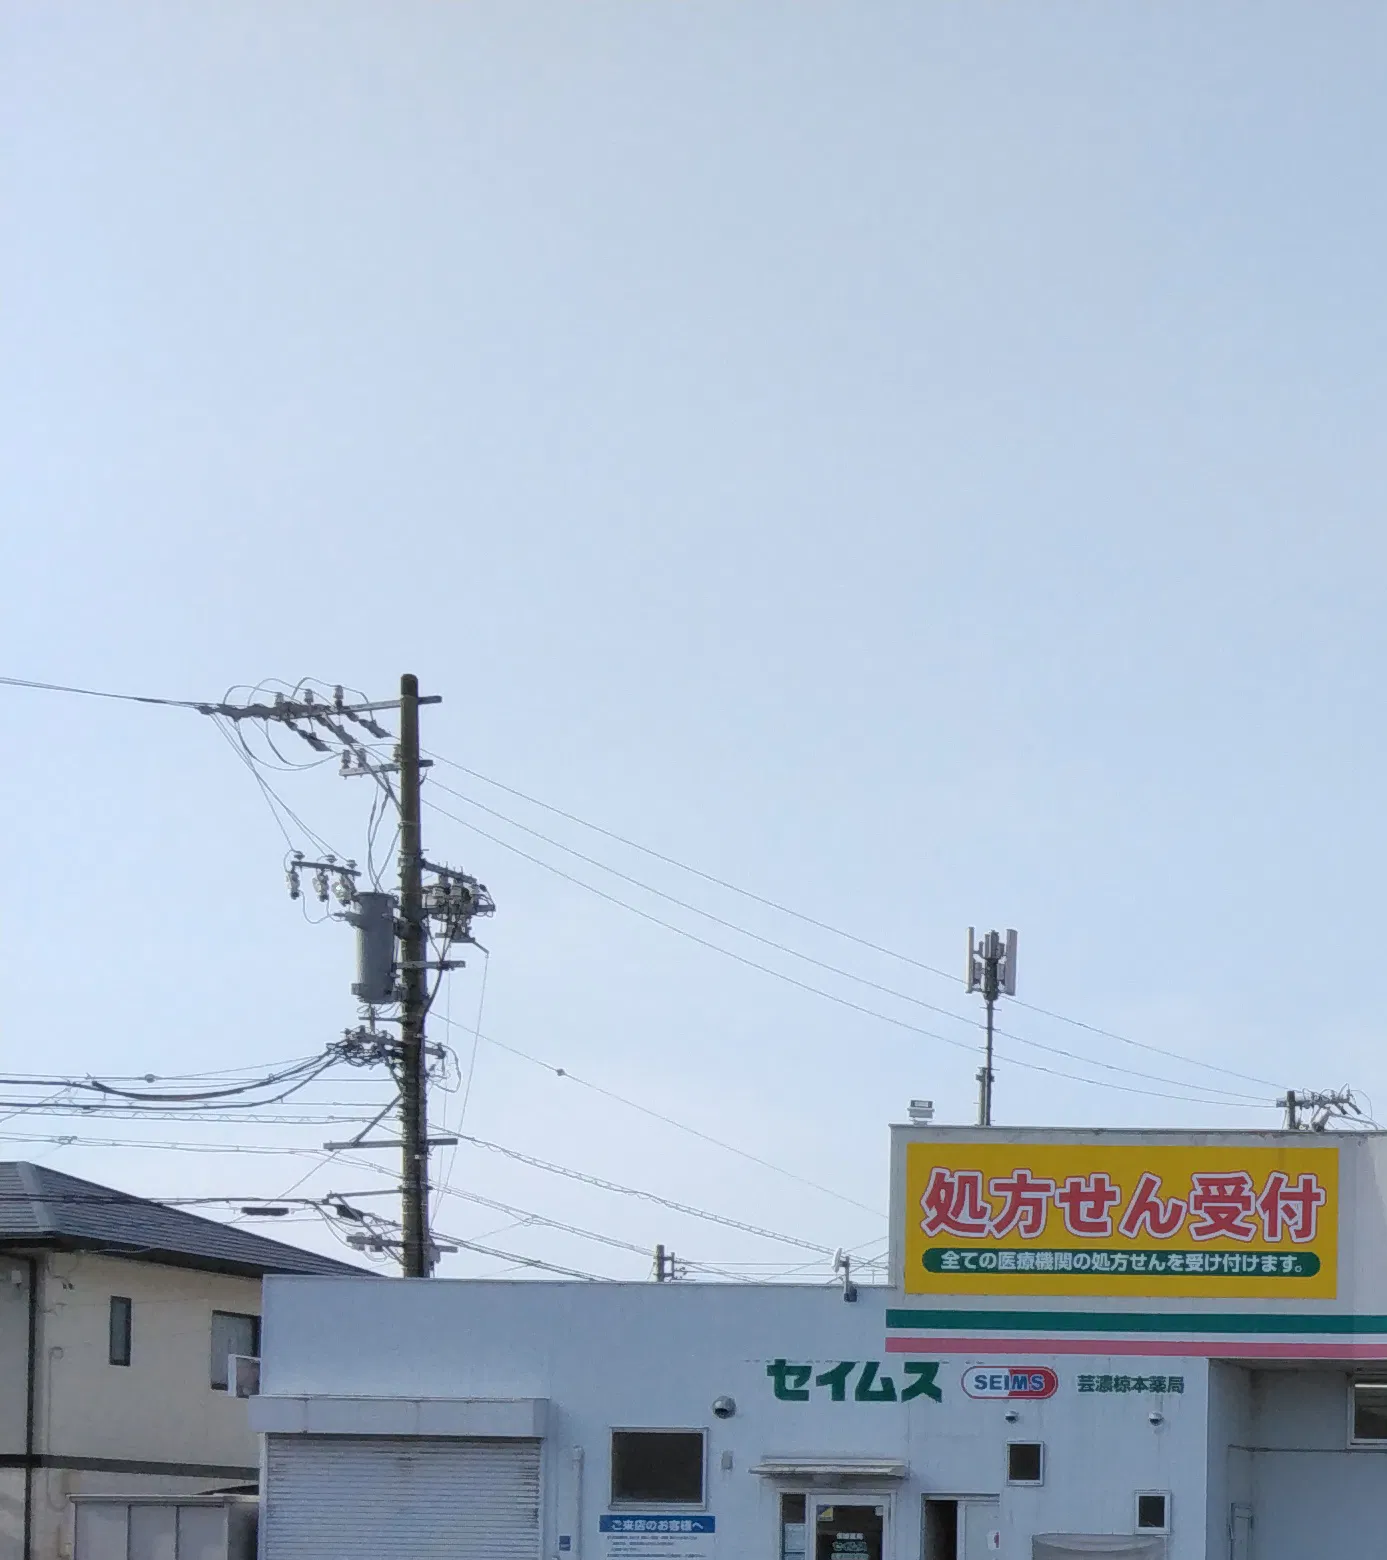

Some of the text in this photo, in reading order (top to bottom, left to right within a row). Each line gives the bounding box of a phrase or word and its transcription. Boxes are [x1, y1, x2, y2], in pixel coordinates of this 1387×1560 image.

[920, 1167, 1326, 1243] 処方せん受付
[940, 1251, 1304, 1273] 全ての医療機関の処方せんを受け付けます。
[766, 1359, 942, 1403] セイムス
[973, 1373, 1046, 1393] SEIMS
[1077, 1375, 1185, 1396] 芸濃椋本薬局
[611, 1519, 704, 1532] ご来店のお客様へ
